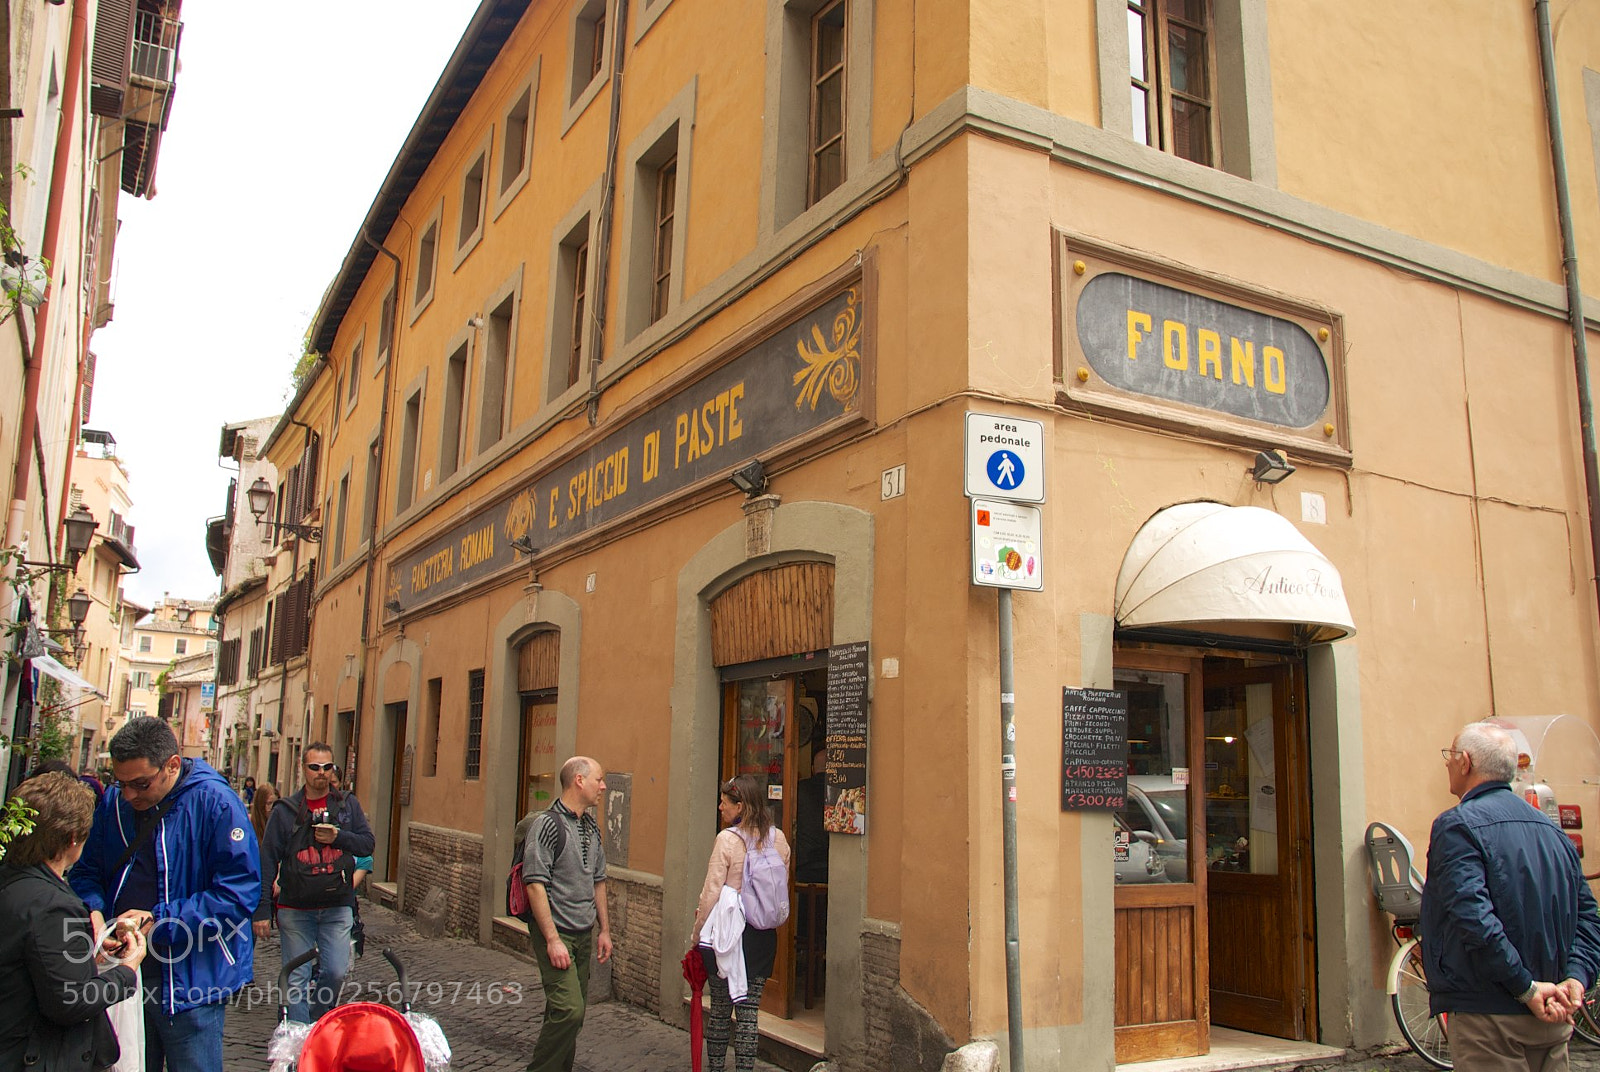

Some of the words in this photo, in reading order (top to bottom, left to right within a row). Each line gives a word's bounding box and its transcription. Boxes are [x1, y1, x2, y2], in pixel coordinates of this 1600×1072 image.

[1127, 309, 1286, 394] FORNO
[980, 434, 1031, 447] pedonale
[994, 423, 1017, 433] area
[410, 545, 453, 595] PANETTERIA
[459, 522, 494, 571] ROMANA
[548, 486, 560, 529] E
[567, 446, 629, 520] SPACCIO
[642, 430, 661, 483] DI
[674, 379, 745, 469] PASTE
[883, 468, 902, 498] 31
[1310, 499, 1319, 519] 8
[1237, 565, 1304, 596] Antico
[1064, 712, 1086, 720] PIZZA
